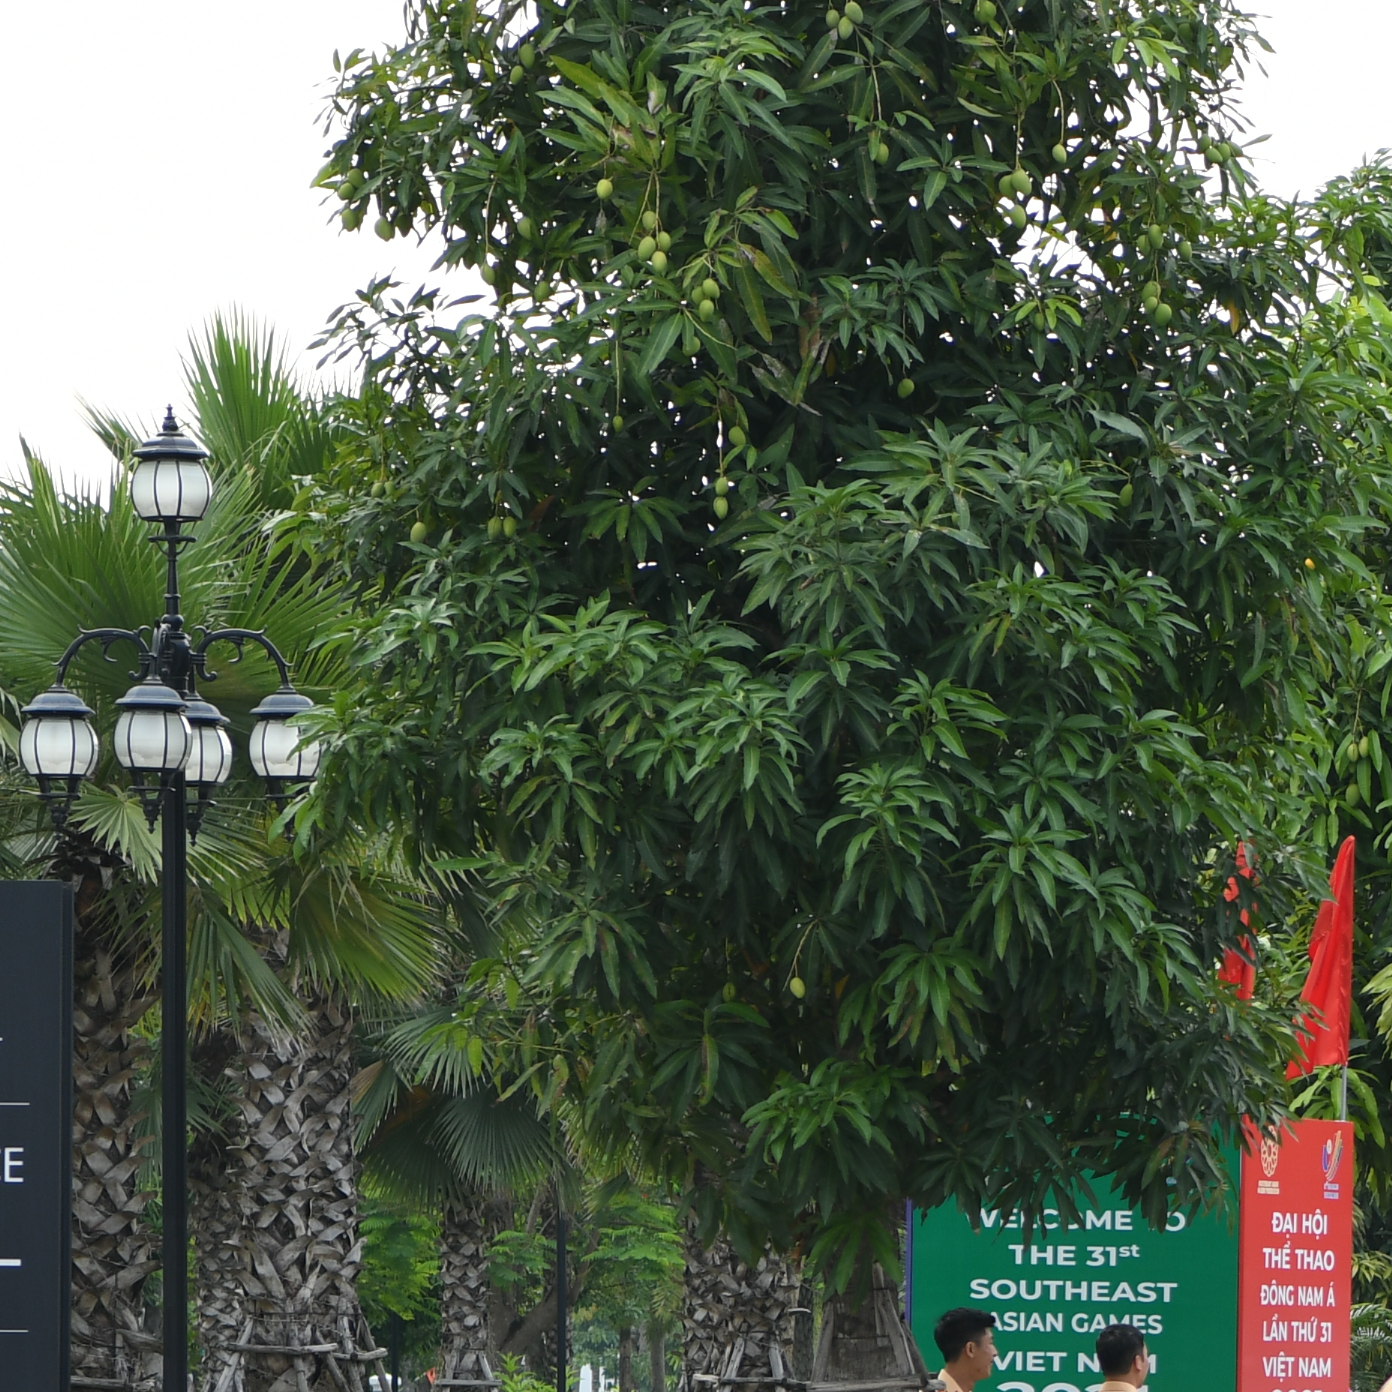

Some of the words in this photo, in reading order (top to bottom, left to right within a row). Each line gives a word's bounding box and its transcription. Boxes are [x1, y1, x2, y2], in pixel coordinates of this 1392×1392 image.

[1271, 1212, 1297, 1239] ĐẠI
[1302, 1208, 1328, 1240] HỘI
[1008, 1244, 1076, 1266] THE
[1085, 1244, 1141, 1267] 31st
[1262, 1240, 1291, 1269] THỂ
[1295, 1249, 1336, 1271] THAO
[969, 1279, 1178, 1302] SOUTHEAST
[1260, 1279, 1295, 1306] ĐÔNG
[1298, 1285, 1324, 1307] NAM
[1326, 1281, 1336, 1307] Á
[992, 1312, 1064, 1333] ASIAN
[1071, 1313, 1163, 1335] GAMES
[1263, 1313, 1287, 1342] LẦN
[1291, 1316, 1317, 1342] THỨ
[1320, 1322, 1332, 1342] 31
[994, 1351, 1068, 1373] VIET
[1262, 1352, 1295, 1383] VIỆT
[1299, 1357, 1331, 1378] NAM
